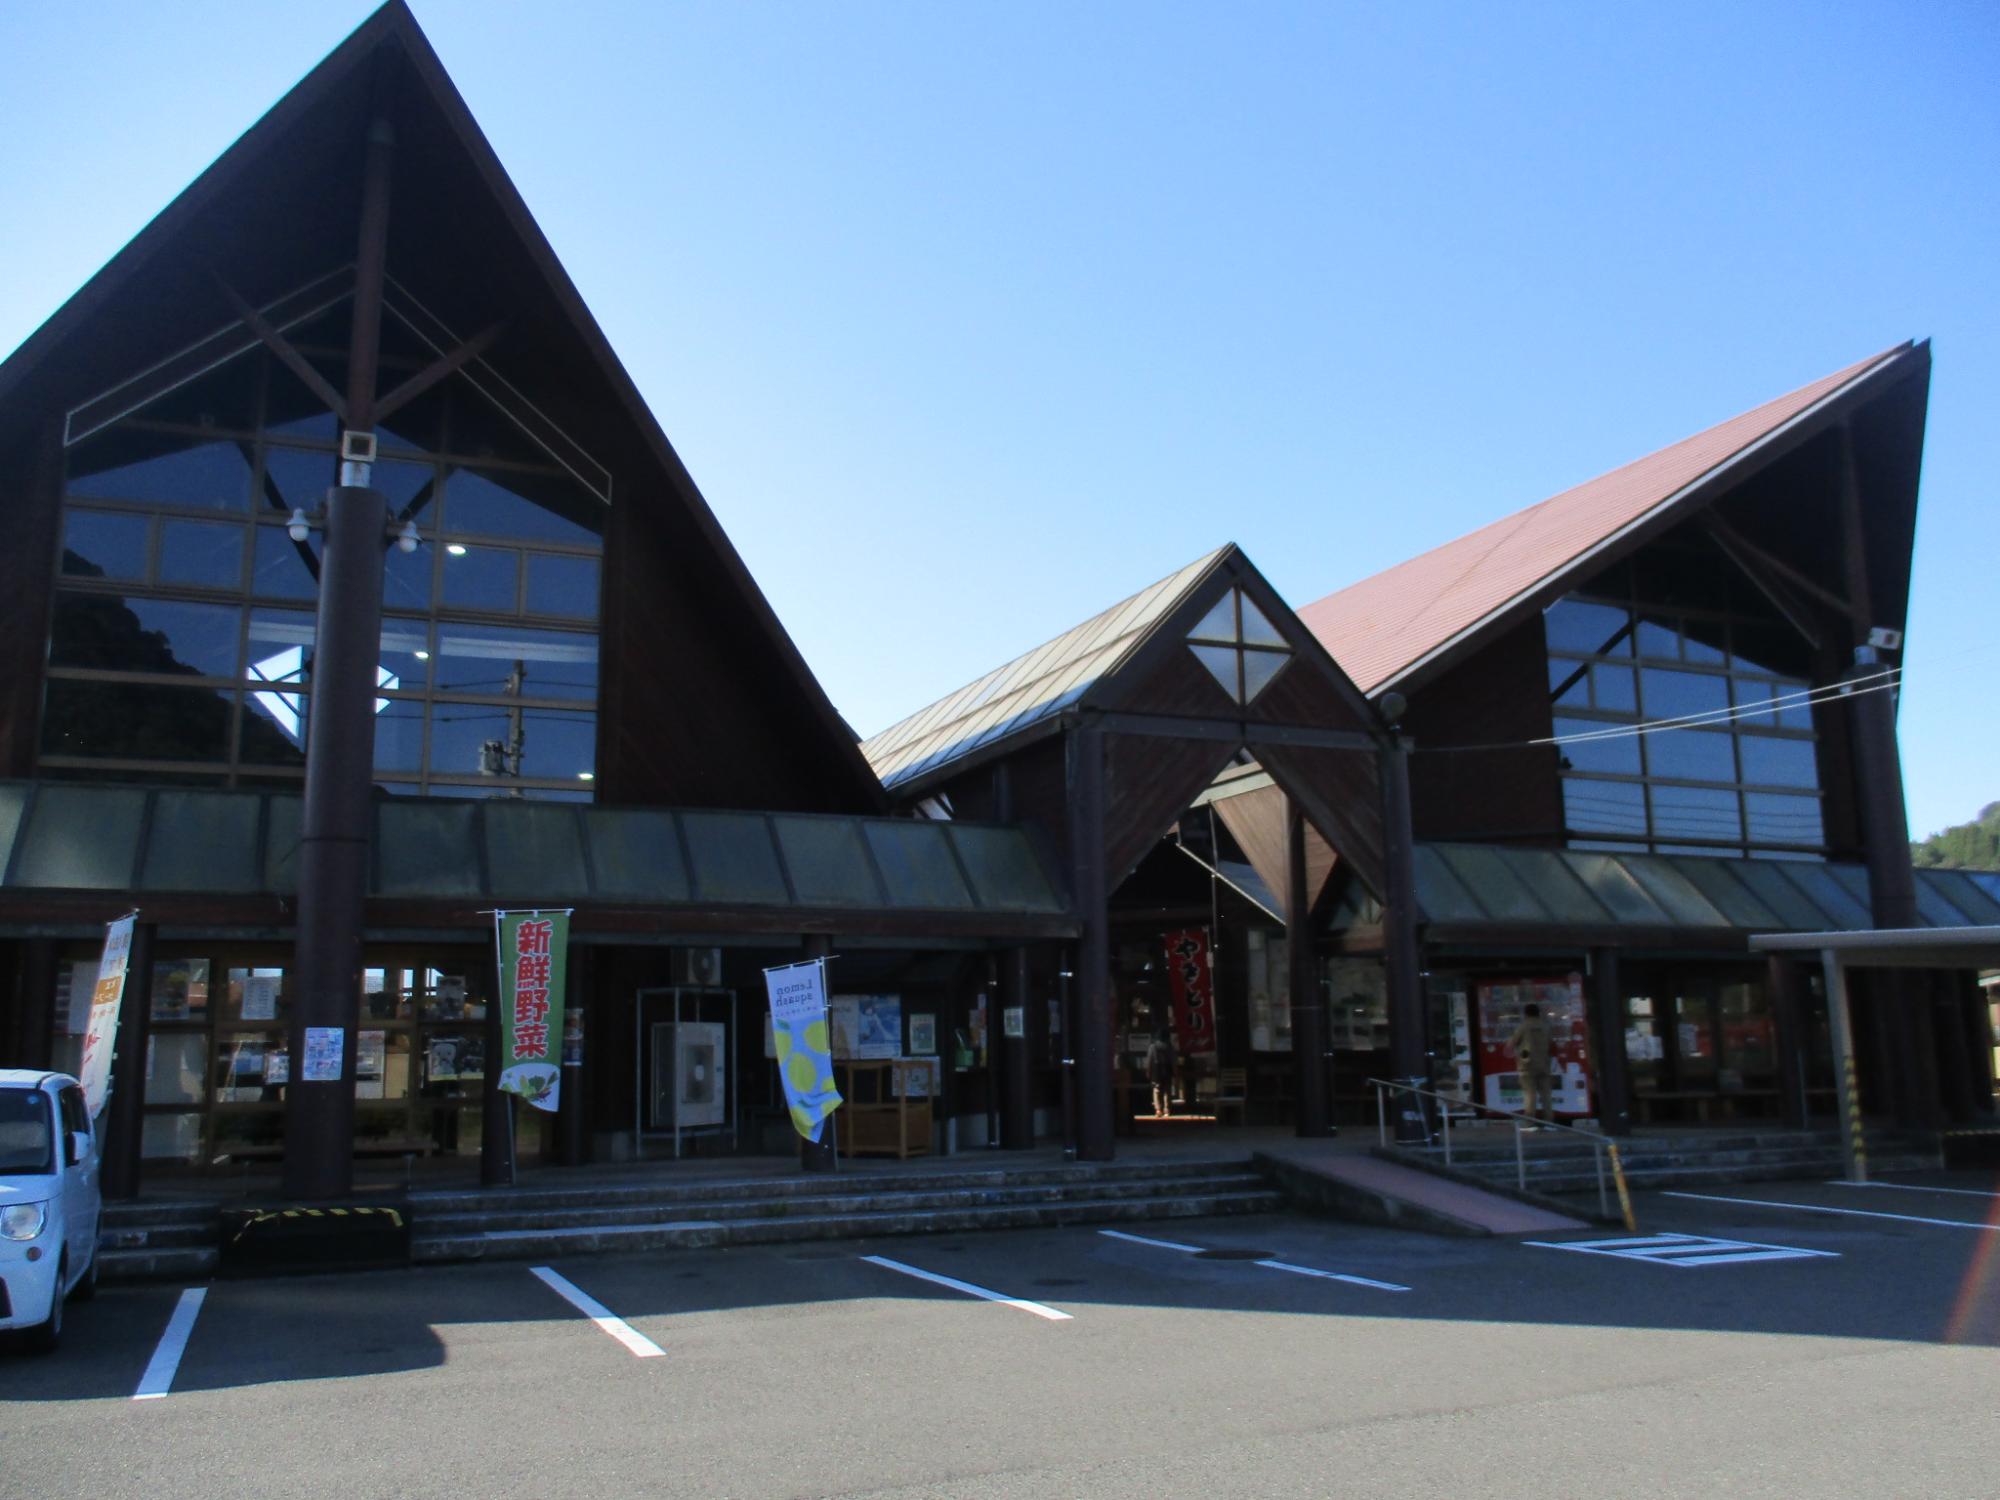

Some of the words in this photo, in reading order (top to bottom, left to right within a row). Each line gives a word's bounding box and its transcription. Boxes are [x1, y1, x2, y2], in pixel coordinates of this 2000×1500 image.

[513, 920, 552, 1059] 新鮮野菜
[1173, 937, 1204, 1031] やきとり
